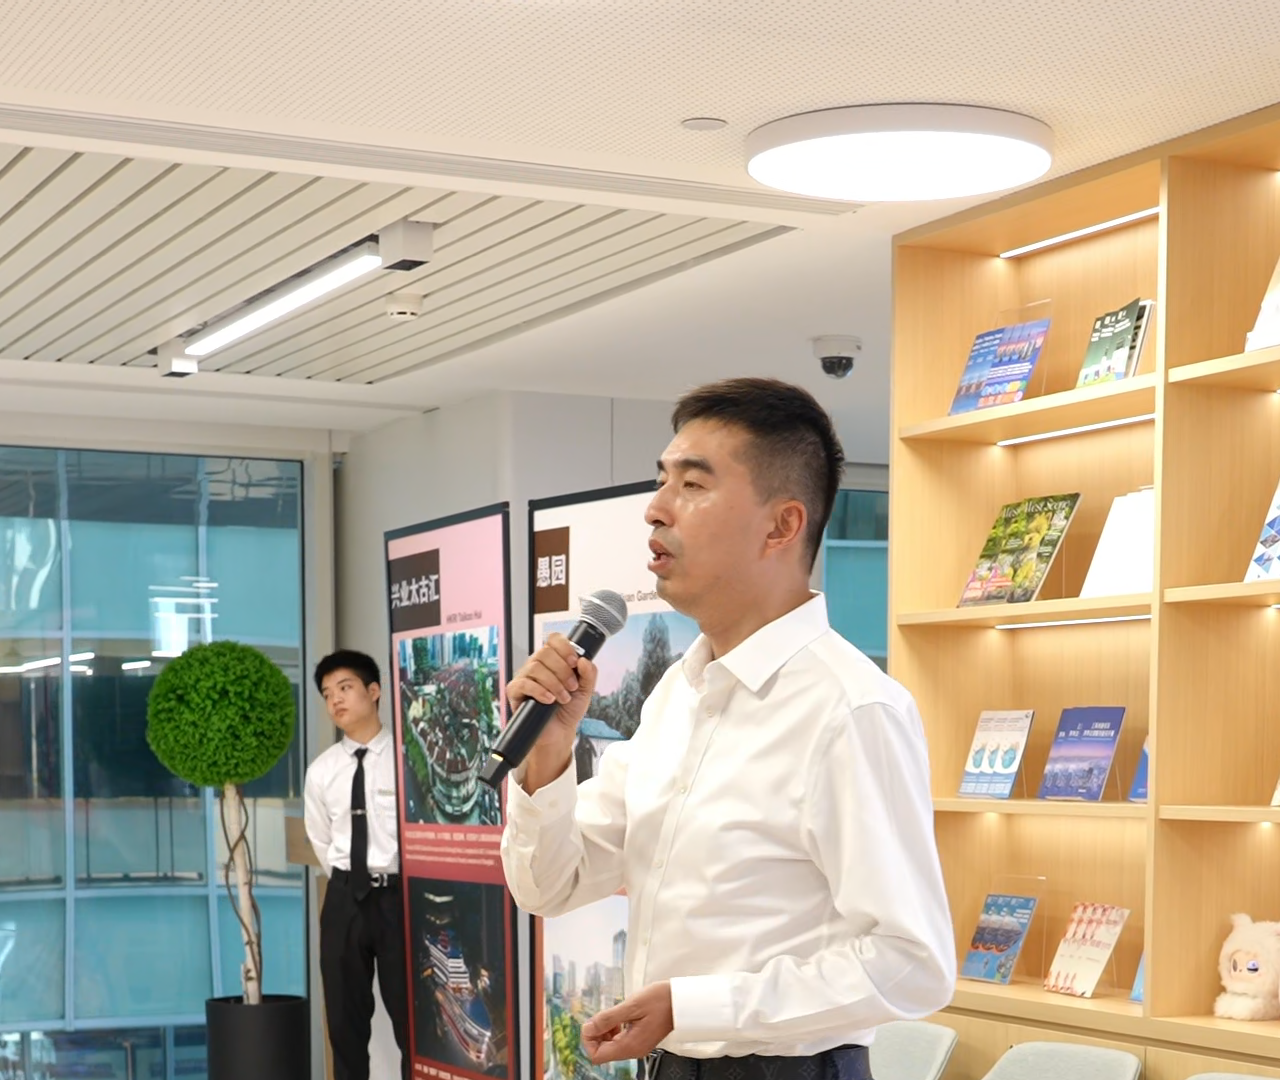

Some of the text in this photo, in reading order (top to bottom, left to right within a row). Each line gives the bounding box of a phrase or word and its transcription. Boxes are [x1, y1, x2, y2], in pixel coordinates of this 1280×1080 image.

[536, 554, 566, 588] 愚园
[391, 574, 440, 610] 兴业太古汇
